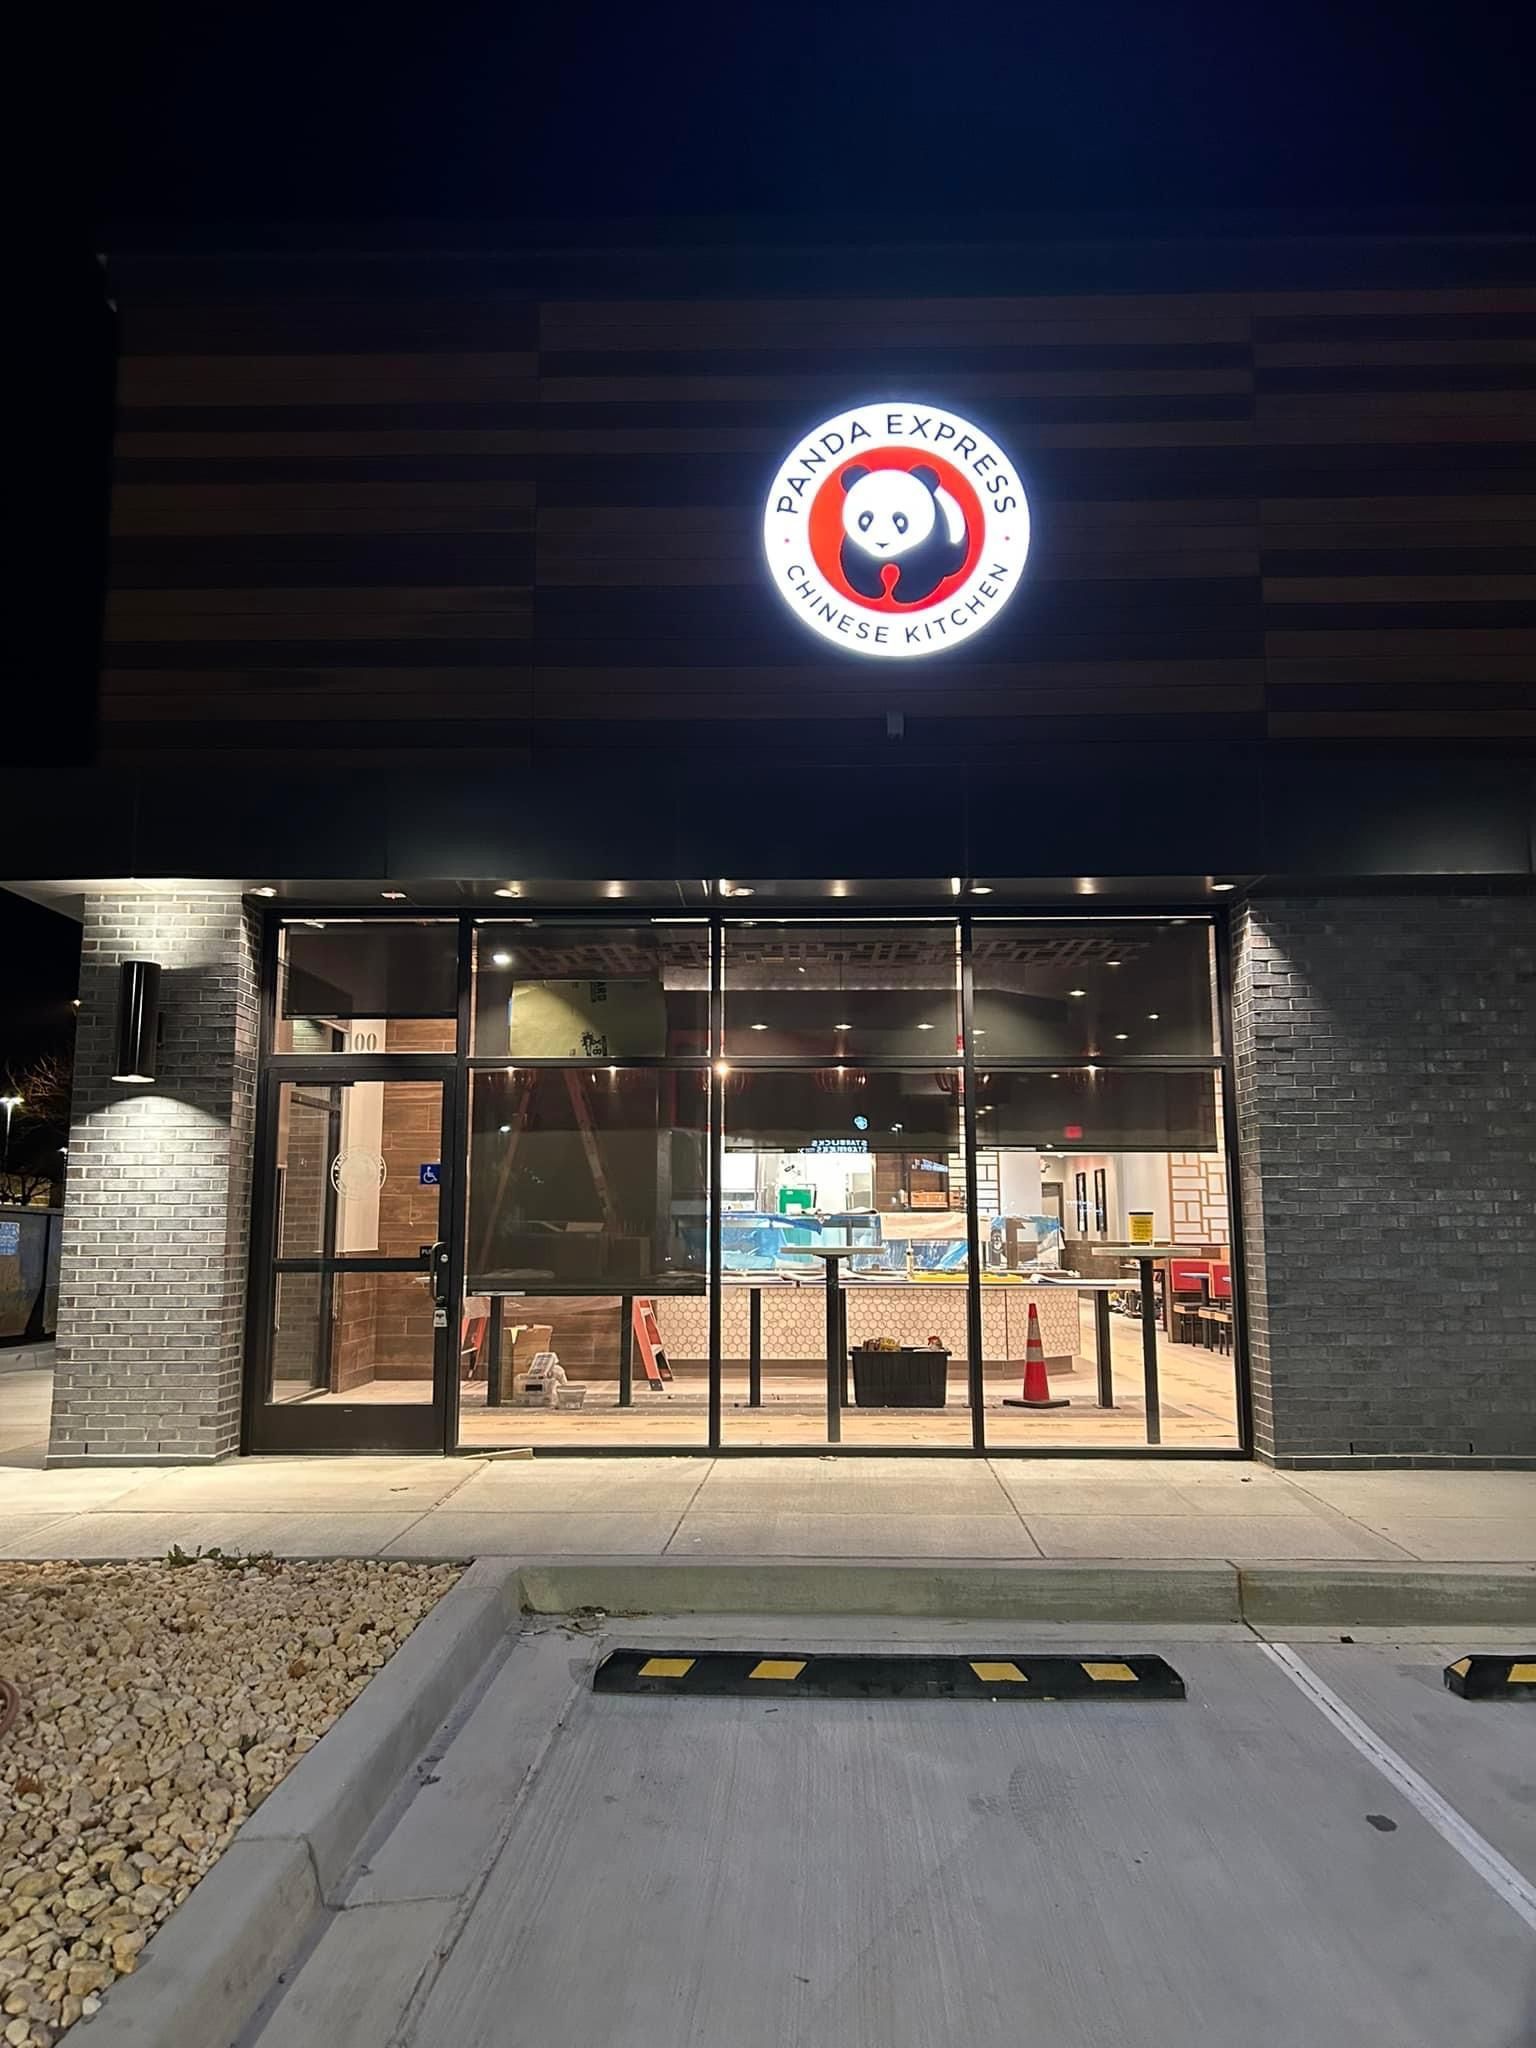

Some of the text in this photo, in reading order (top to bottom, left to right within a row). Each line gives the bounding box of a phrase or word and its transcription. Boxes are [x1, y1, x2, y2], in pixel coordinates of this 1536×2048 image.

[777, 414, 1016, 514] PANDA EXPRESS
[787, 563, 1009, 644] CHINESE KITCHEN
